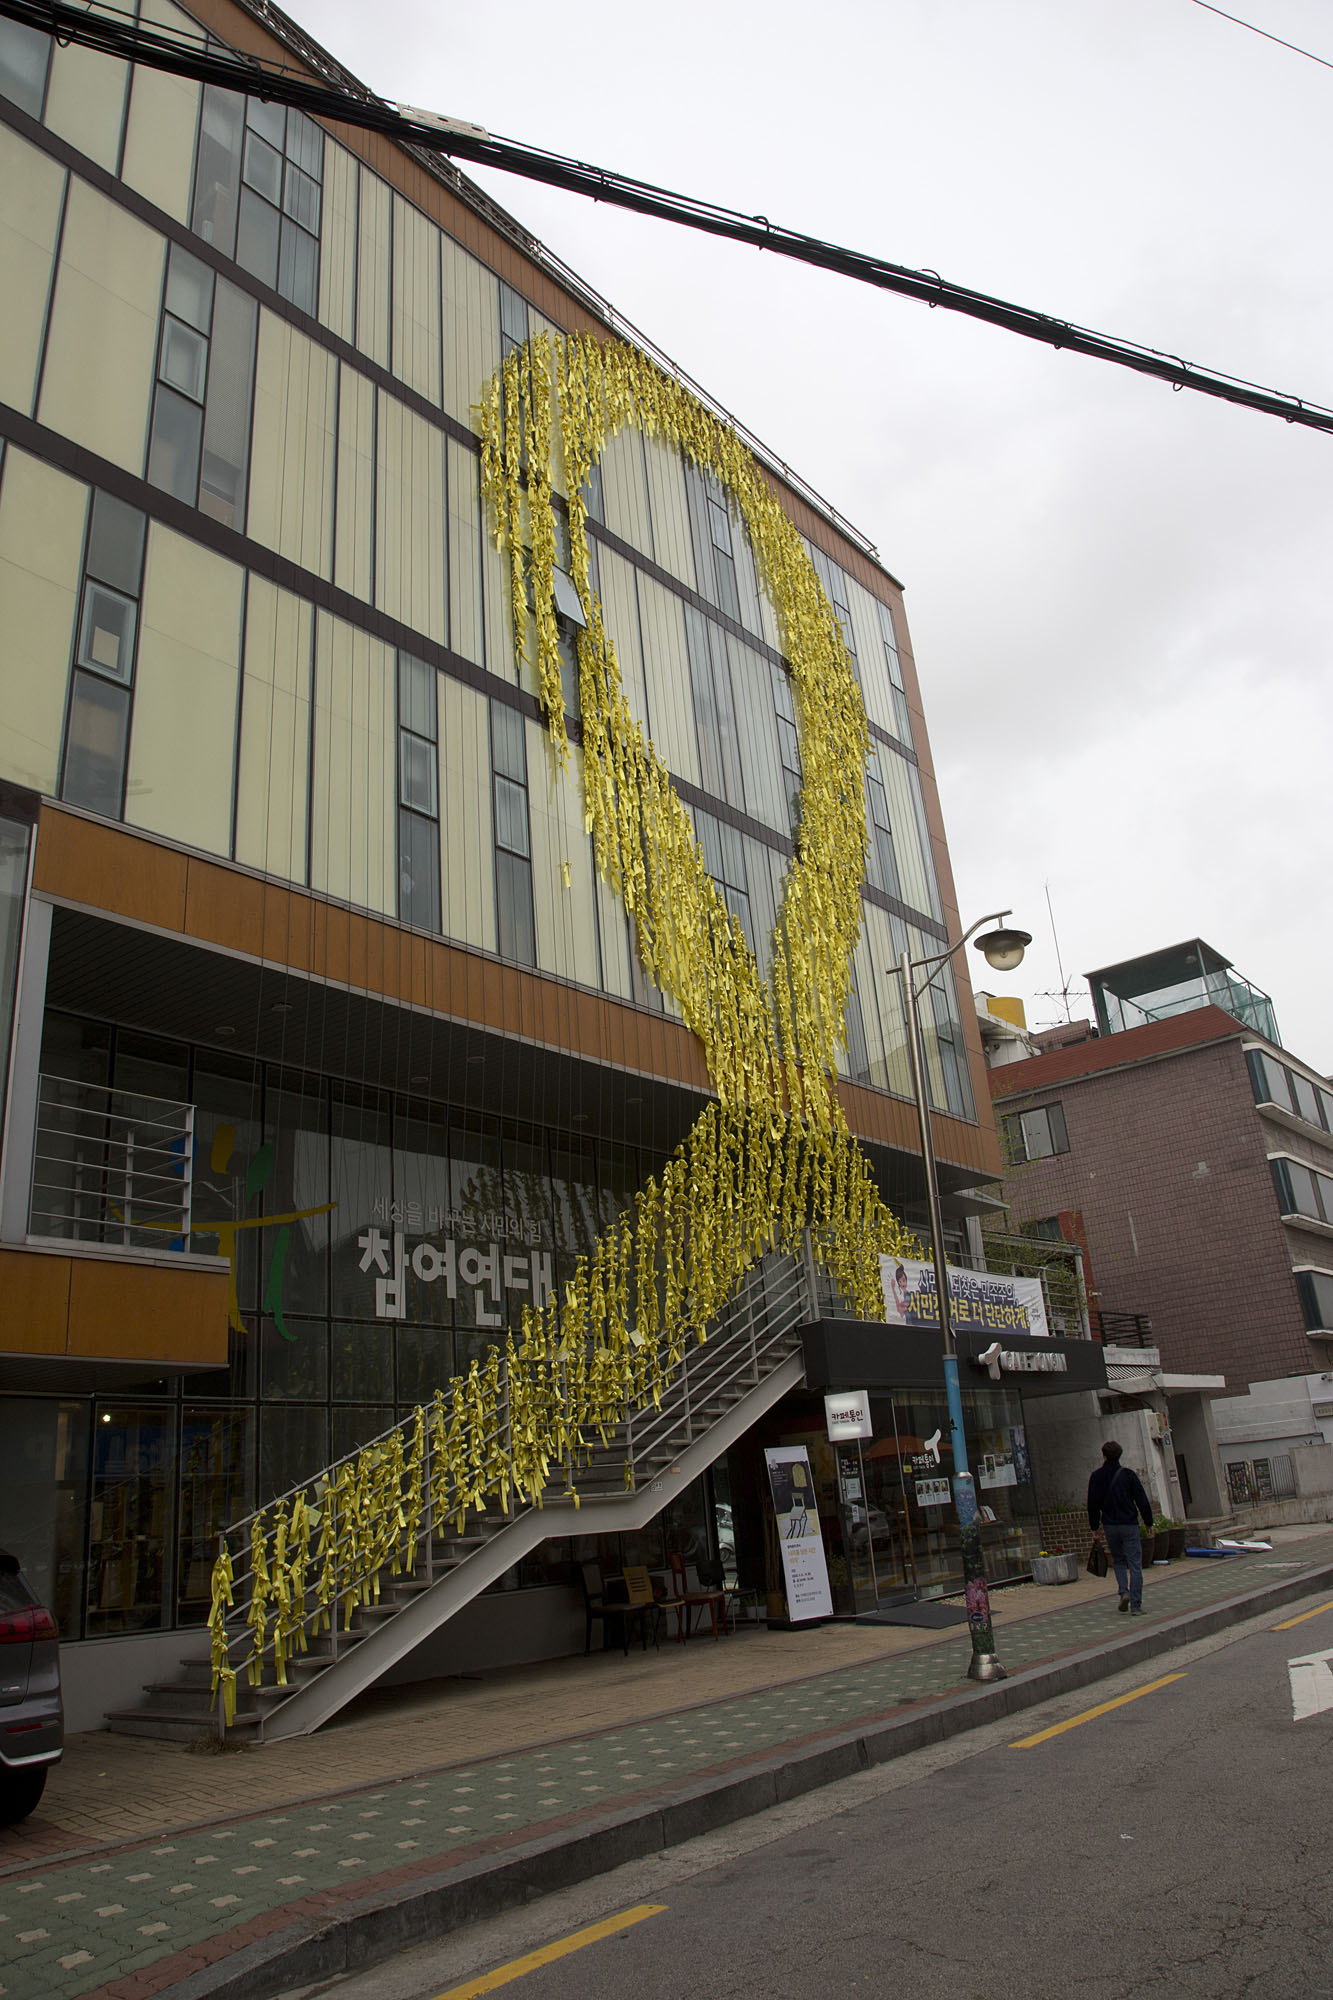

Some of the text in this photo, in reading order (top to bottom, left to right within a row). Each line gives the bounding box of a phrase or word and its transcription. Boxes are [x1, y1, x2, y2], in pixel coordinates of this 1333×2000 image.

[372, 1196, 542, 1243] 세상을 바꾸는 시민의 힘
[358, 1228, 553, 1327] 참여연대
[952, 1274, 980, 1301] 되찾은
[971, 1301, 985, 1326] 더
[985, 1303, 1031, 1329] 단단하게!
[831, 1409, 864, 1422] 카페통인
[911, 1453, 935, 1469] 카페통인
